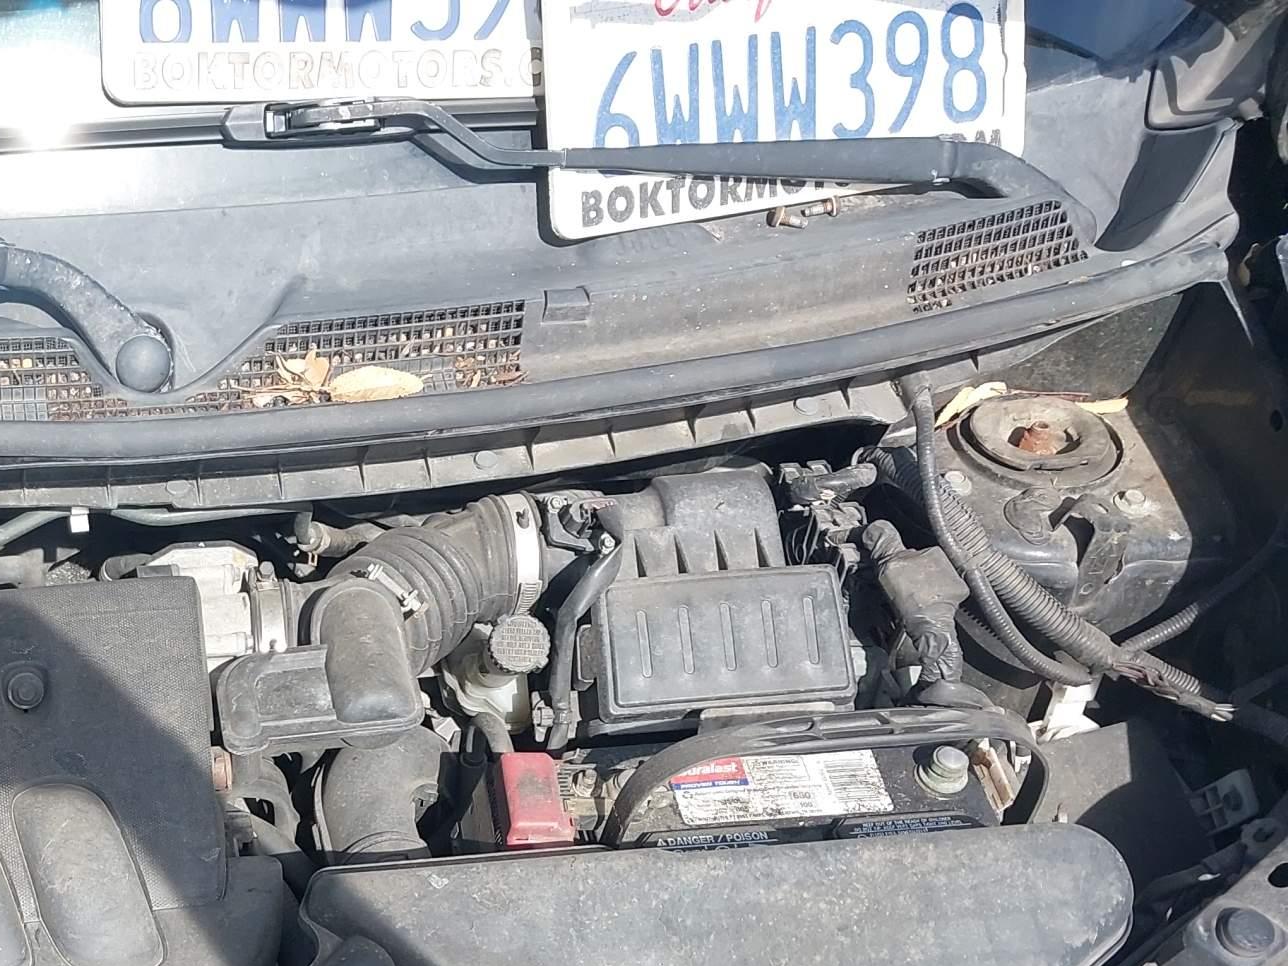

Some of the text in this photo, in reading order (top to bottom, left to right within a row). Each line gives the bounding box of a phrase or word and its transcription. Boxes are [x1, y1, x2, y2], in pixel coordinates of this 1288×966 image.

[594, 2, 987, 149] 6WWW398
[678, 760, 739, 777] uralast
[668, 834, 713, 846] DANGER
[727, 832, 769, 842] POISON
